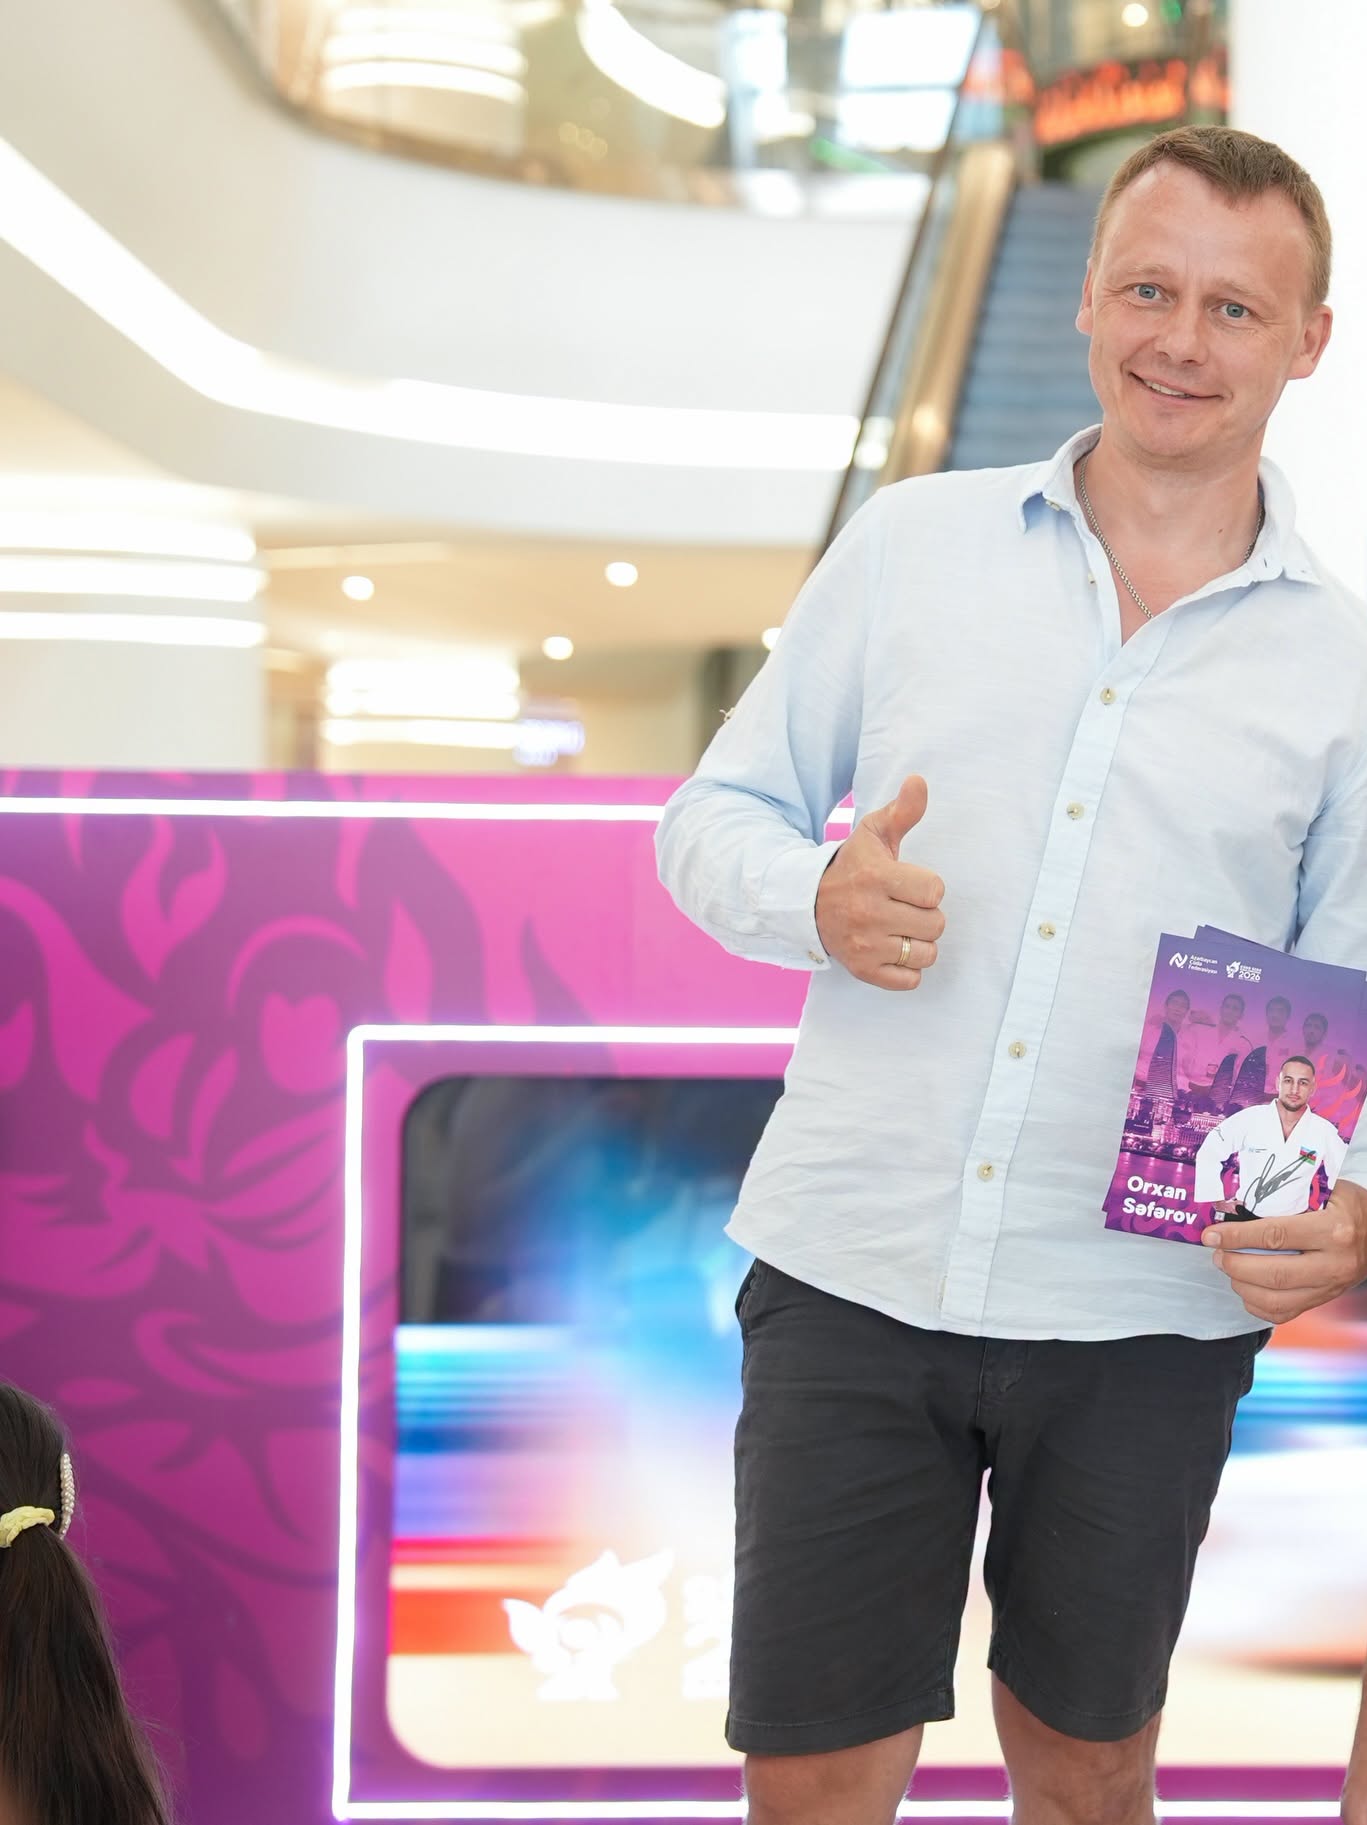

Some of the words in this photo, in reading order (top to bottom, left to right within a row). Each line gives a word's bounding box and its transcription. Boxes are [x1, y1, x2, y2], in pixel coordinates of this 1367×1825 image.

[1239, 971, 1261, 981] 2026
[1127, 1175, 1187, 1201] Orxan
[1122, 1197, 1198, 1225] Səfərov
